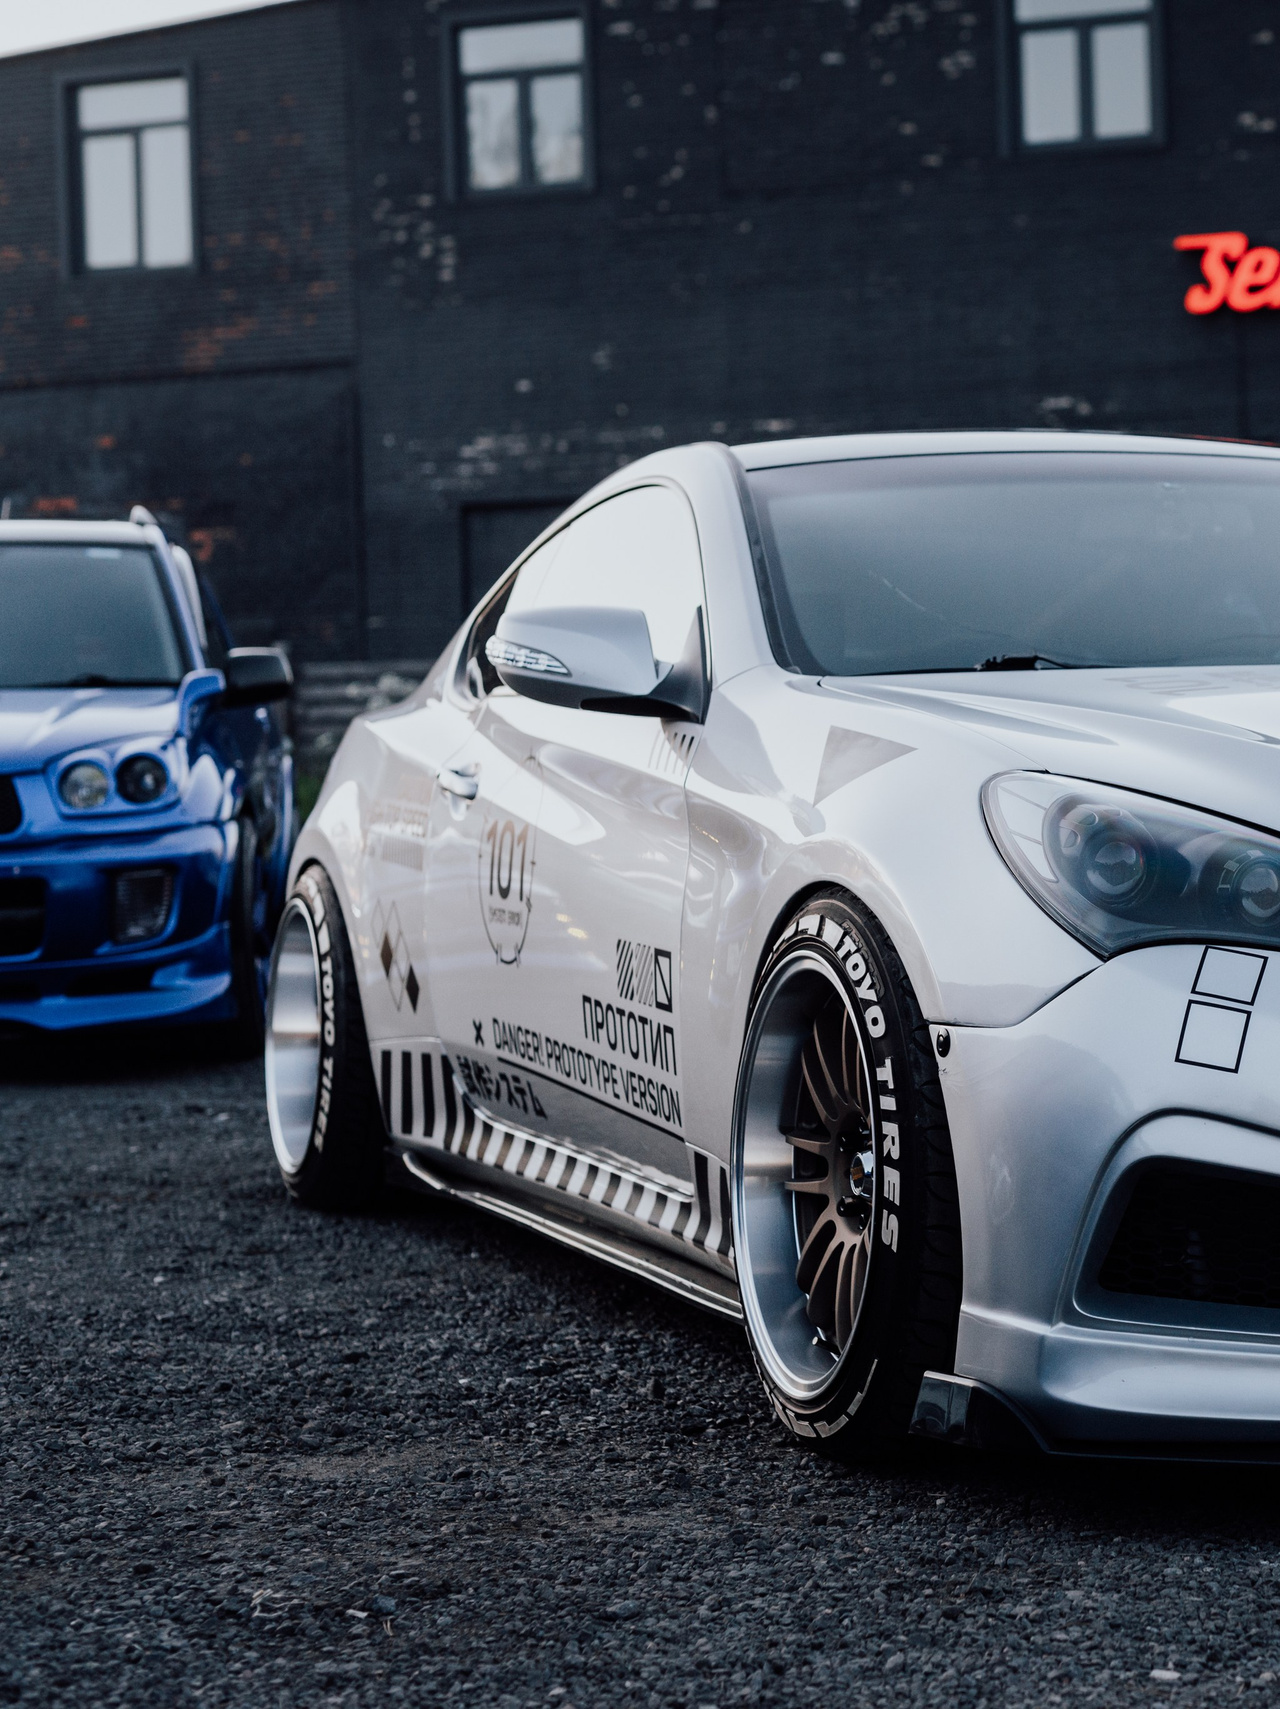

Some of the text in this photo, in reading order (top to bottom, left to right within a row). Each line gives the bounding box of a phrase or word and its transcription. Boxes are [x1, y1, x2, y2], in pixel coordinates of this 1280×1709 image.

[486, 820, 529, 901] 101
[321, 956, 335, 1047] TOYO
[582, 994, 677, 1077] ПРОТОТИП
[545, 1036, 621, 1100] PROTOTYPE
[619, 1066, 683, 1128] VERSION
[837, 934, 886, 1038] TOYO
[876, 1056, 900, 1253] TIRES
